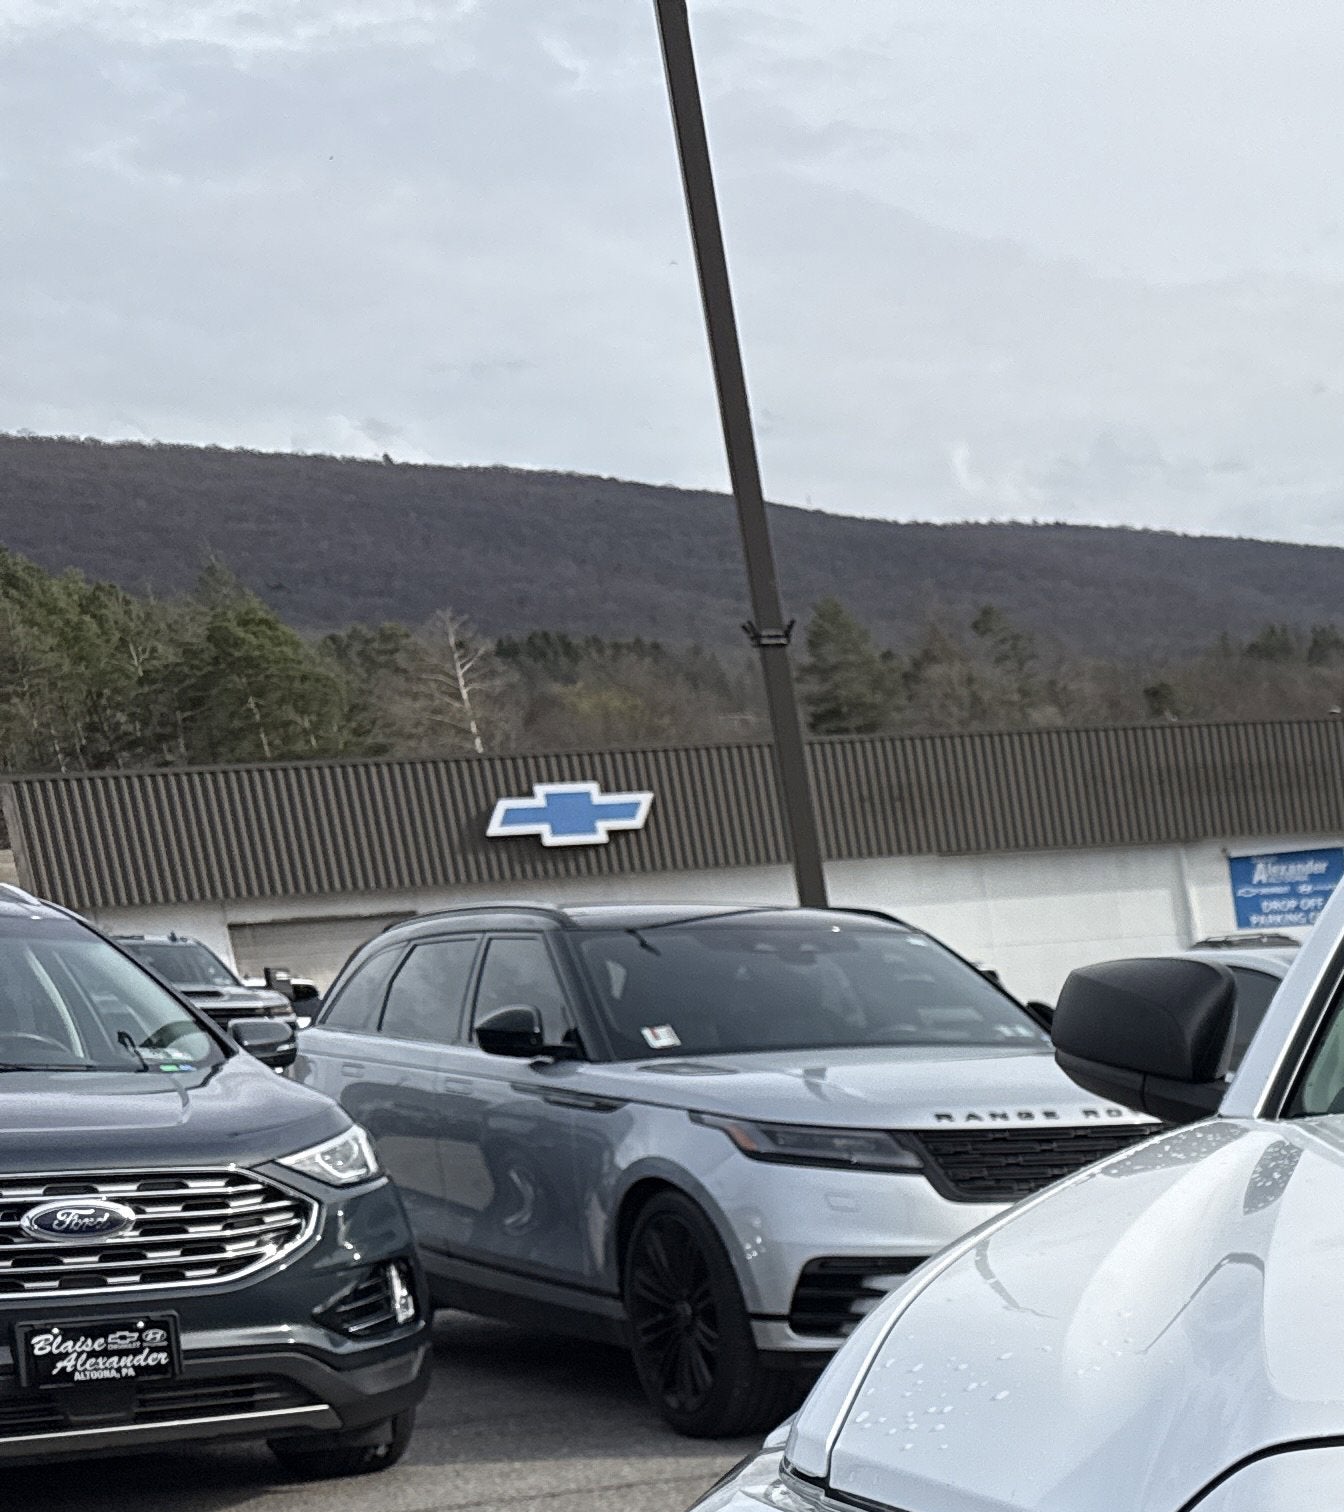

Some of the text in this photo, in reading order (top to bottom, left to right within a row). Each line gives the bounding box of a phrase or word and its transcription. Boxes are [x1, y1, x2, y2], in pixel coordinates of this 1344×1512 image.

[1262, 899, 1299, 914] DROP
[934, 1108, 1060, 1122] RANGE
[52, 1208, 110, 1231] Ford
[30, 1333, 107, 1357] Blaise
[51, 1347, 170, 1375] Alexander
[121, 1366, 136, 1378] PA
